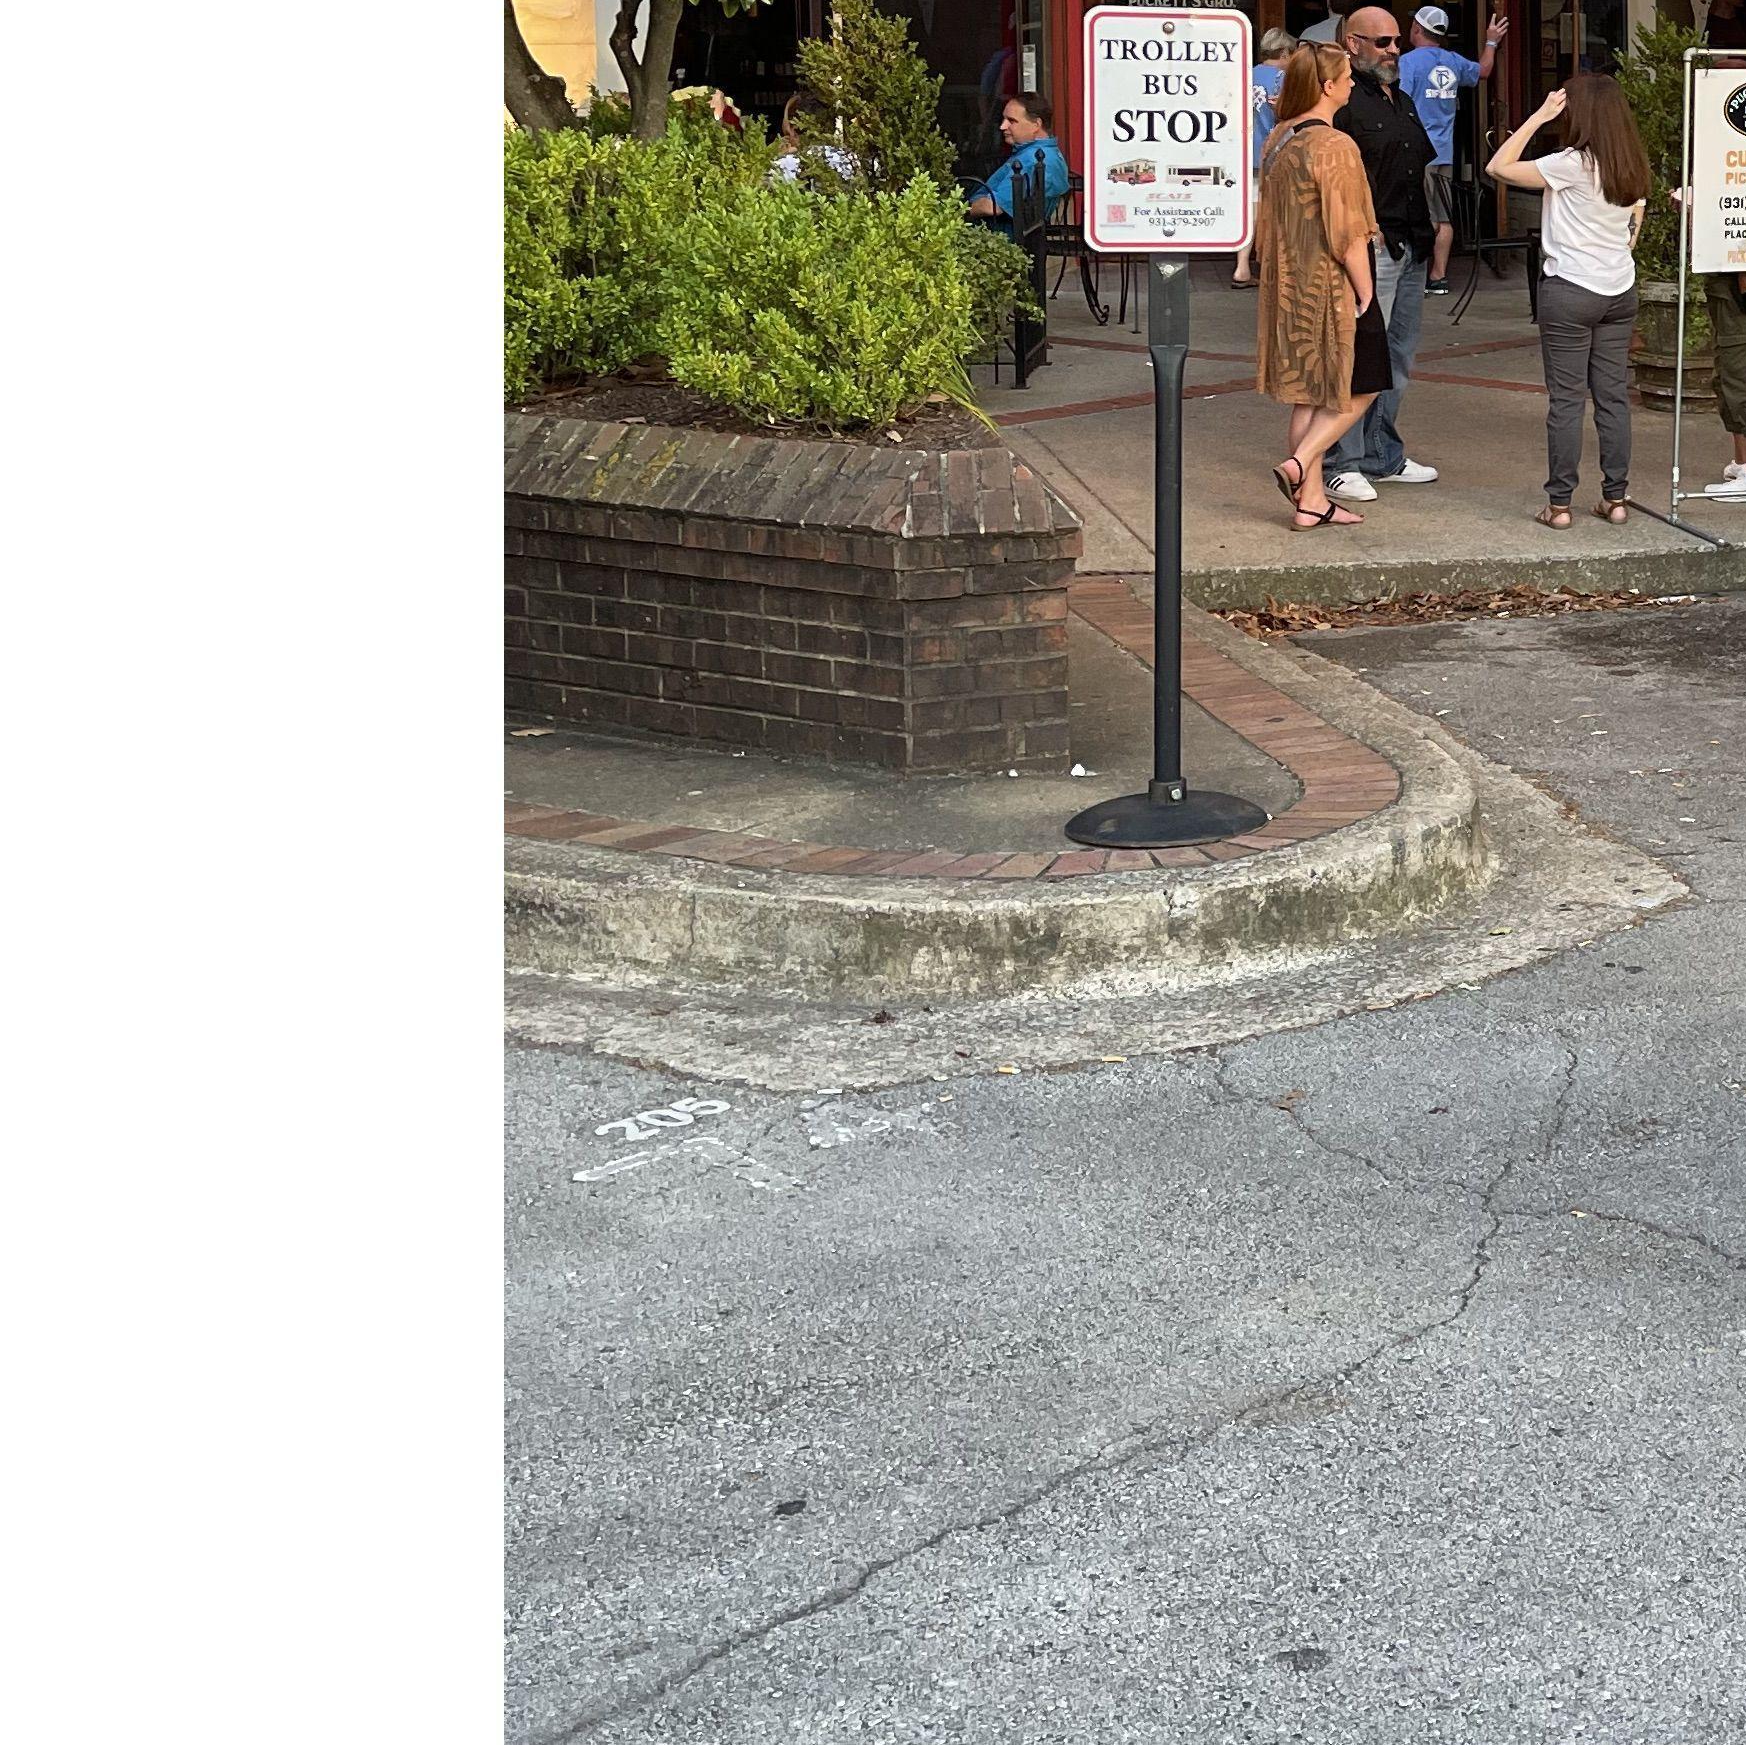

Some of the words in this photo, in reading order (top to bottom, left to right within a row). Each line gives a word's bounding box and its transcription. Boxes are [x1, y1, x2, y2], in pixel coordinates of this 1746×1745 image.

[1100, 39, 1238, 62] TROLLEY
[1142, 74, 1198, 96] BUS
[1112, 109, 1228, 143] STOP
[1134, 207, 1151, 216] For
[1154, 206, 1201, 216] Assistance
[1148, 217, 1217, 227] 931-379-2907
[1724, 216, 1746, 226] CALL
[595, 1097, 731, 1142] 205
